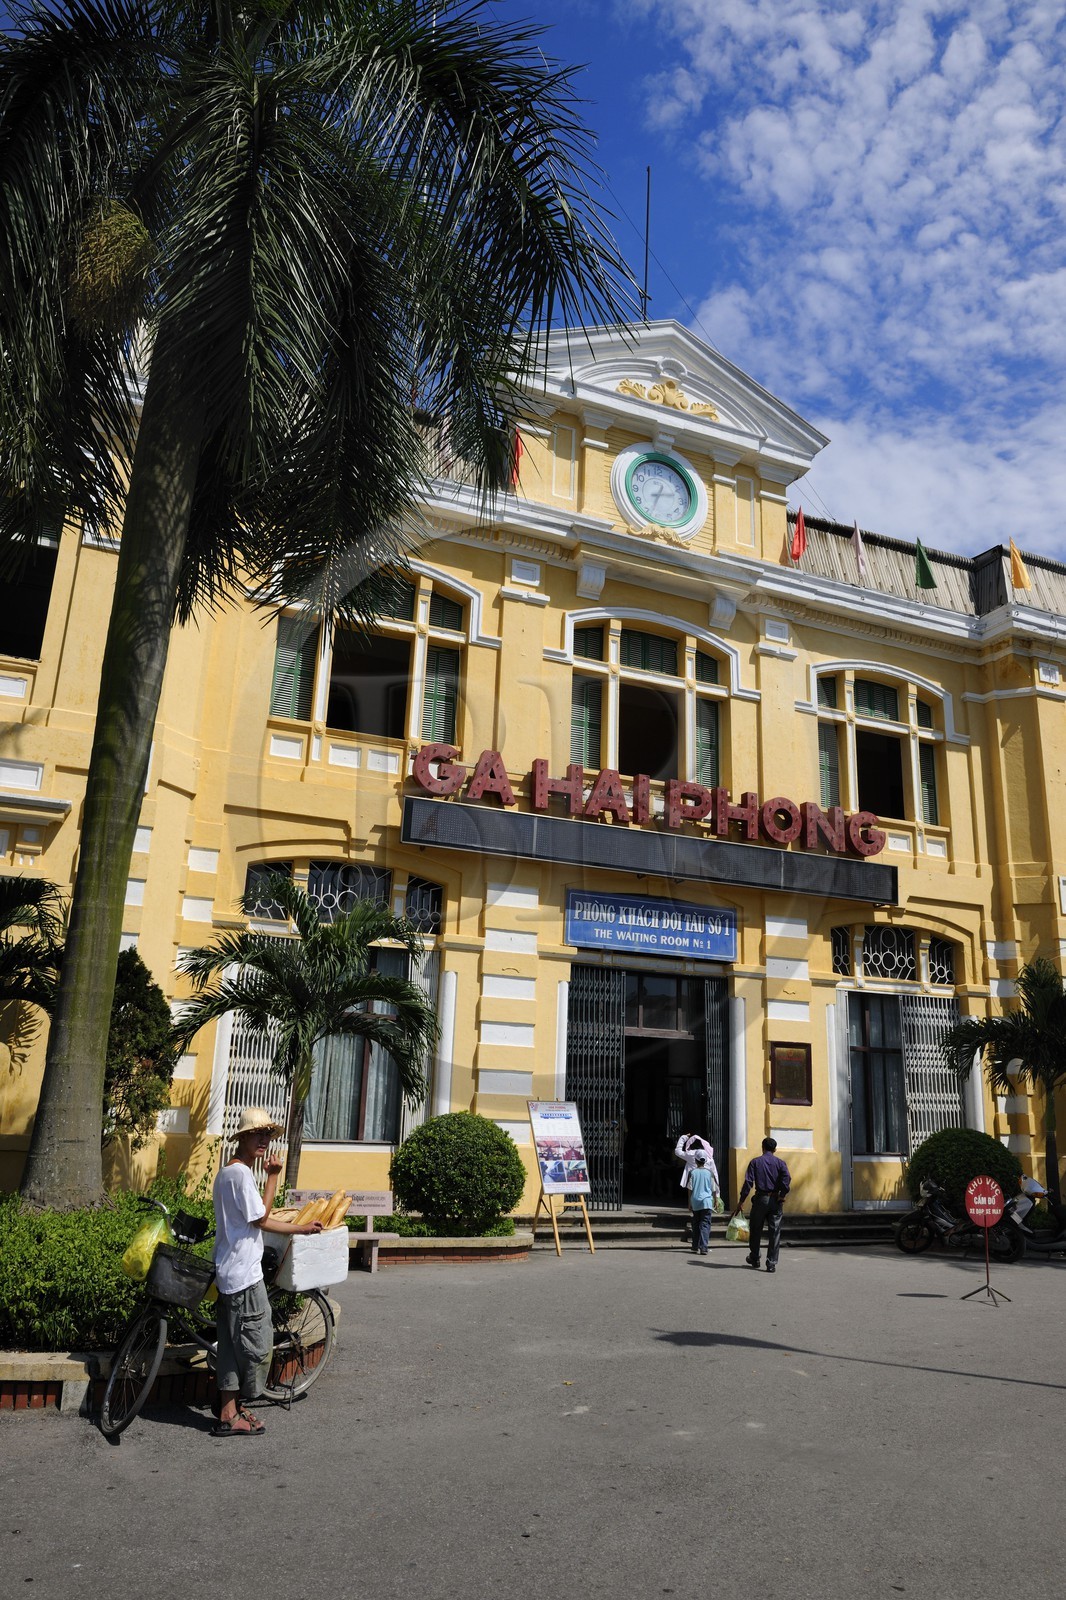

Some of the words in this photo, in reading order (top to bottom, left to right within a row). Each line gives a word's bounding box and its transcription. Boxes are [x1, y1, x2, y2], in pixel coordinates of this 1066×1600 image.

[636, 473, 645, 483] 10
[654, 466, 663, 477] 12
[632, 484, 639, 492] 9
[636, 496, 642, 504] 8
[412, 742, 516, 807] GA
[532, 758, 651, 825] HAI
[664, 778, 887, 857] PHONG
[573, 900, 616, 924] PHÒNG
[618, 905, 660, 929] KHÁCH
[661, 911, 683, 932] ĐỢI
[684, 911, 705, 934] TÀU
[708, 914, 723, 936] SỐ
[724, 918, 730, 936] 1
[594, 928, 613, 940] THE
[616, 930, 657, 944] WAITING
[660, 935, 690, 947] ROOM
[706, 940, 711, 949] 1
[968, 1178, 983, 1195] KHU
